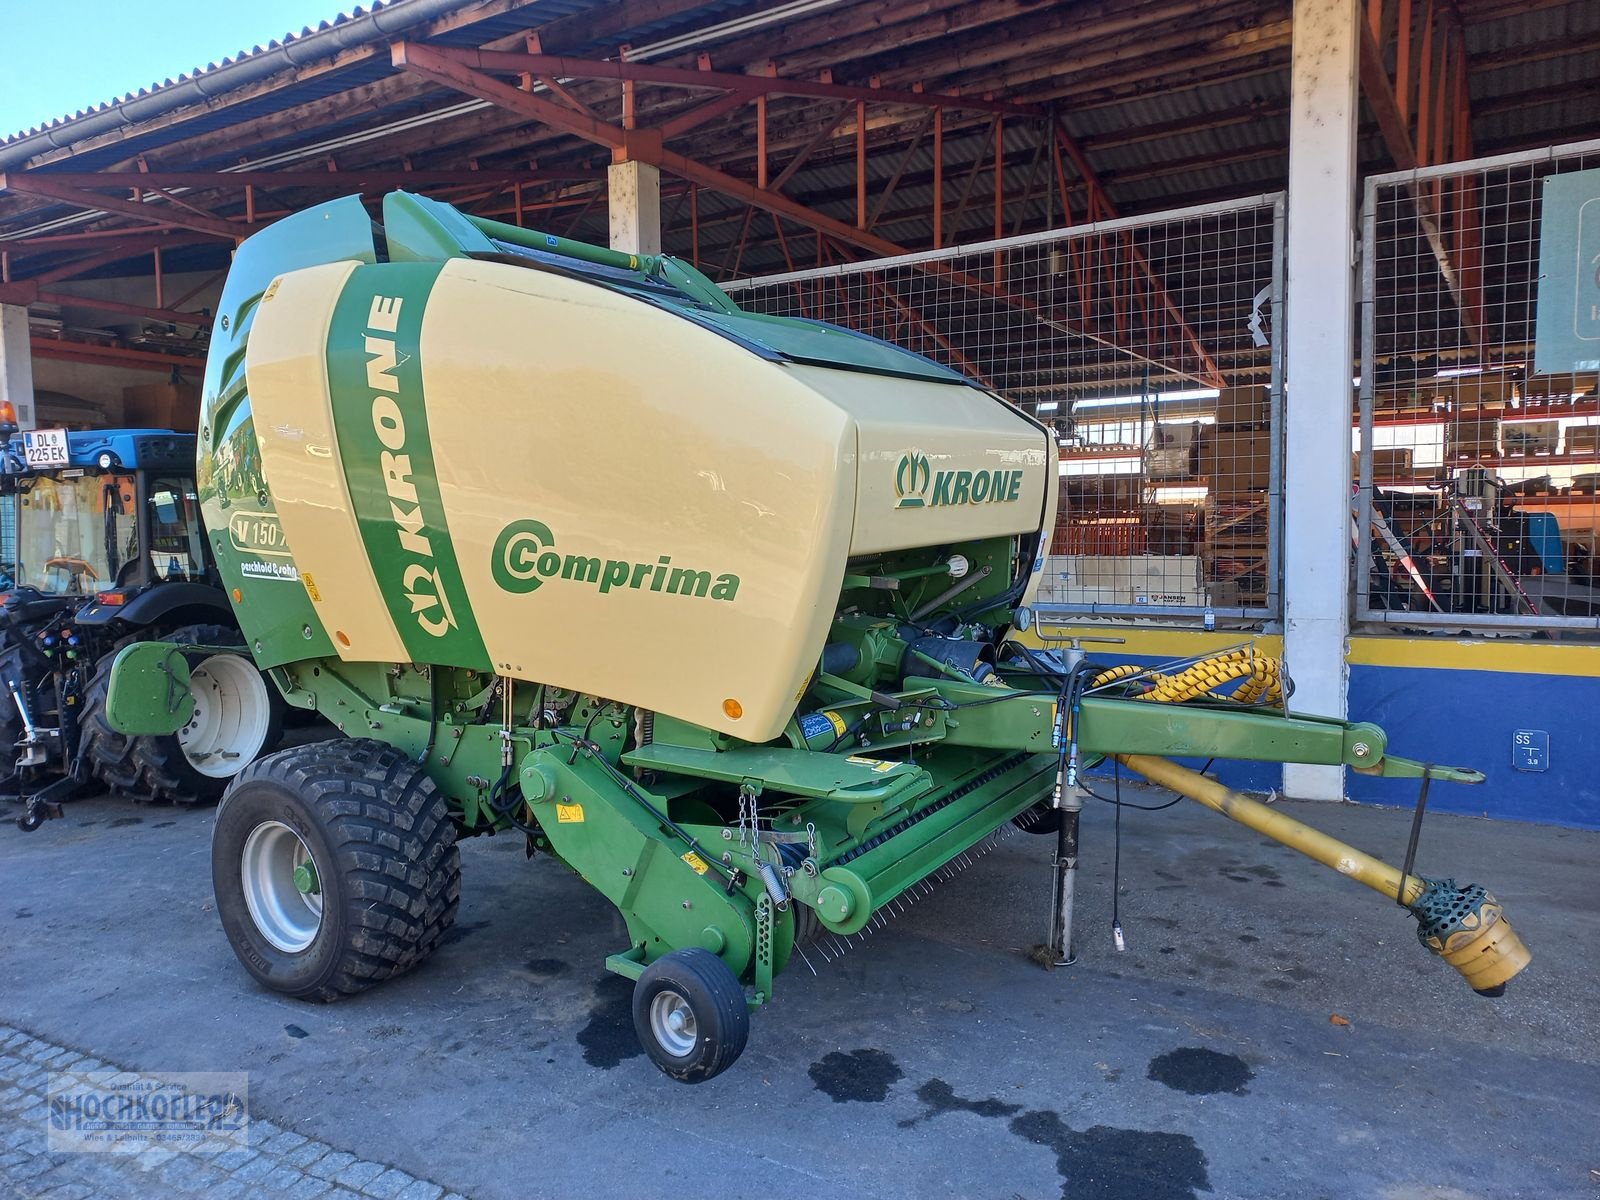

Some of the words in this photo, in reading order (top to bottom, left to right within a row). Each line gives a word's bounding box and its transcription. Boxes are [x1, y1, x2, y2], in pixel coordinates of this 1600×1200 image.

[37, 434, 50, 447] DL
[364, 295, 433, 557] KRONE
[29, 448, 49, 461] 225
[51, 447, 65, 460] EK
[929, 469, 1023, 506] KRONE
[237, 520, 249, 542] V
[253, 522, 277, 545] 150
[491, 519, 741, 601] Comprima
